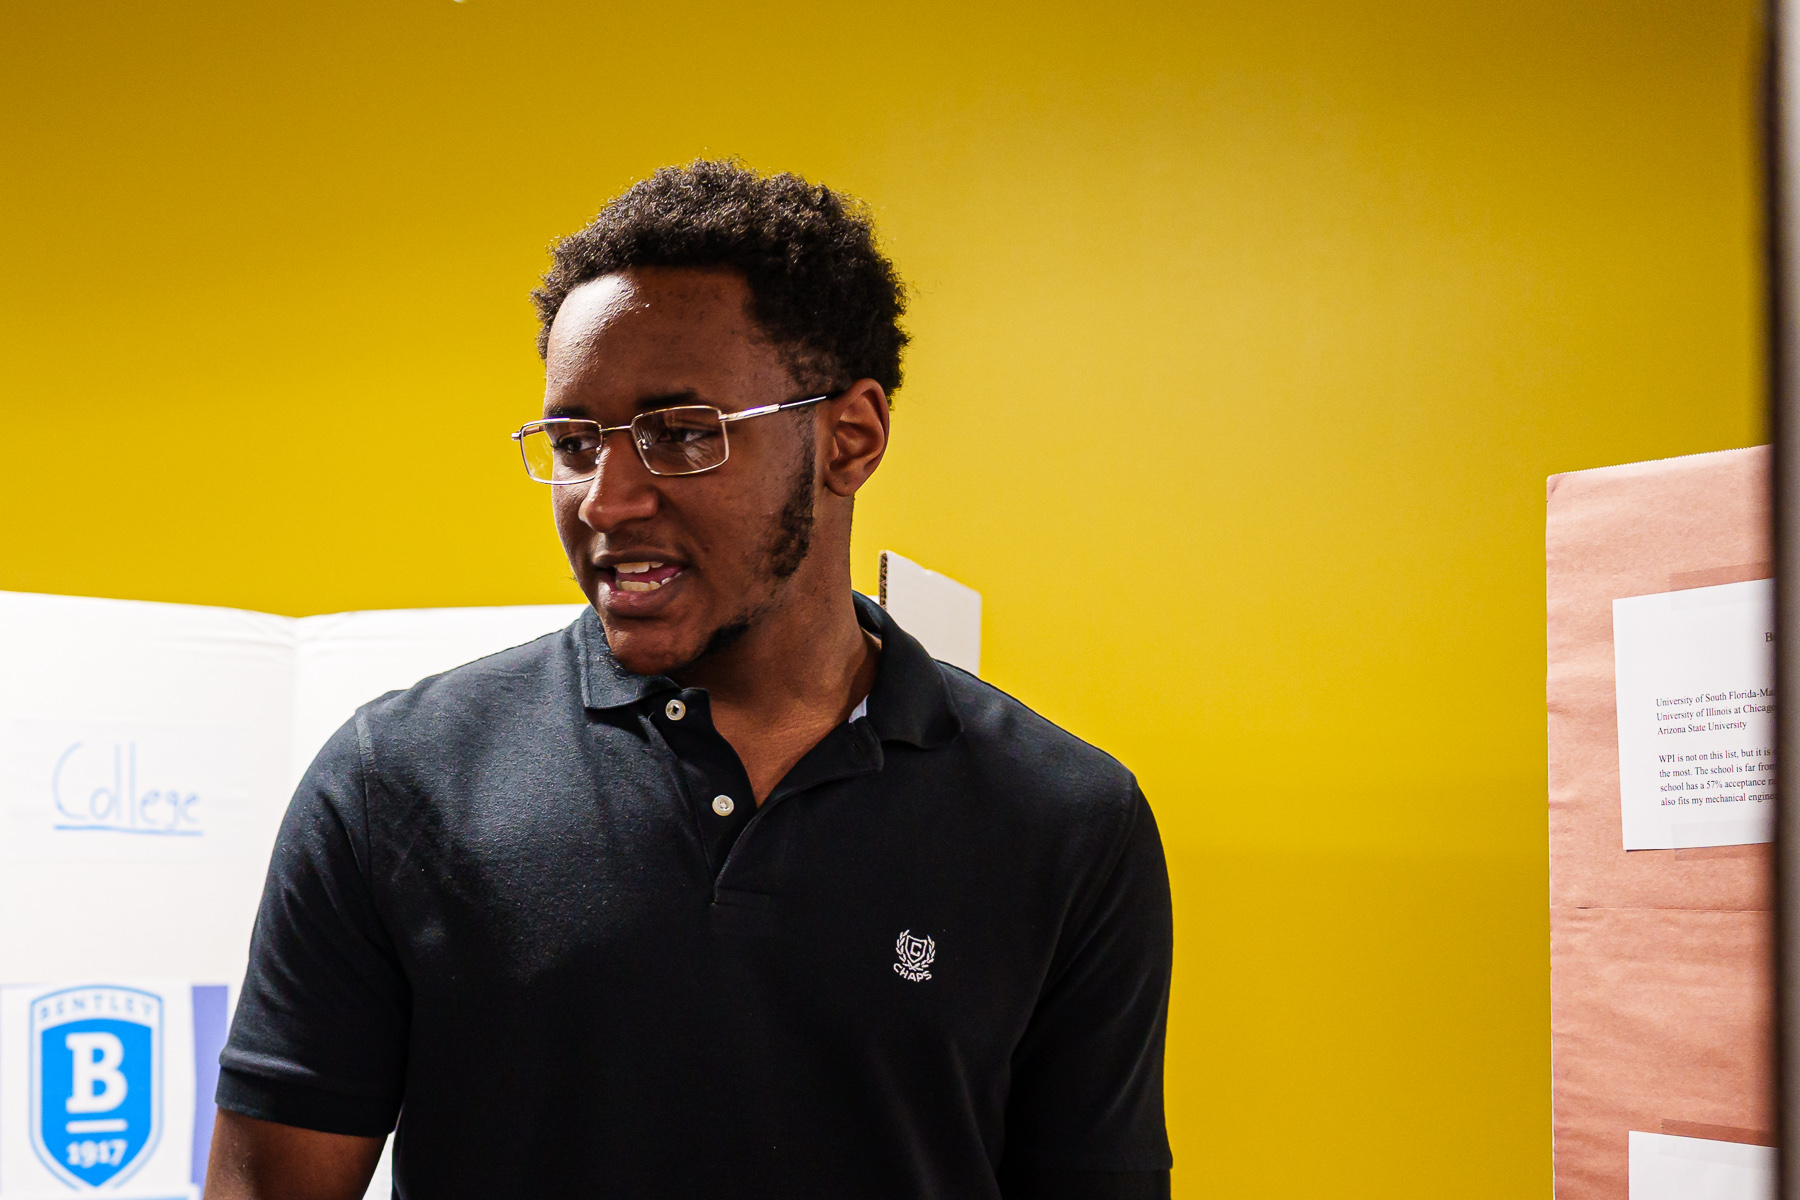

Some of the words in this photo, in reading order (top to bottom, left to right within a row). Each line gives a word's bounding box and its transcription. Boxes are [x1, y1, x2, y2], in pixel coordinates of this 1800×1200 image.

[1656, 695, 1693, 707] University
[1696, 693, 1703, 703] of
[1705, 692, 1727, 702] South
[1729, 688, 1775, 699] Florida-Ma
[1656, 710, 1694, 721] University
[1696, 708, 1704, 718] of
[1706, 707, 1732, 717] Illinois
[1734, 706, 1741, 714] at
[1657, 725, 1686, 735] Arizona
[1688, 723, 1706, 733] State
[1708, 720, 1747, 731] University
[1659, 755, 1675, 763] WPI
[1677, 754, 1683, 762] is
[1710, 751, 1723, 760] this
[1725, 749, 1739, 760] list,
[1741, 748, 1753, 757] but
[1755, 748, 1761, 756] it
[1764, 747, 1771, 756] is
[1660, 769, 1671, 777] the
[1673, 767, 1692, 776] most.
[1695, 766, 1708, 775] The
[1710, 764, 1734, 774] school
[1736, 764, 1742, 772] is
[1745, 763, 1755, 772] far
[53, 742, 200, 828] College
[1660, 782, 1683, 792] school
[1686, 781, 1698, 790] has
[1706, 780, 1723, 789] 57%
[1725, 777, 1766, 789] acceptance
[1661, 797, 1675, 806] also
[1678, 796, 1689, 804] fits
[1692, 797, 1703, 806] my
[1705, 793, 1745, 803] mechanical
[910, 942, 922, 956] C
[893, 963, 932, 982] CHAPS
[39, 993, 154, 1023] BENTLEY
[65, 1031, 128, 1113] B
[67, 1139, 128, 1167] 1917
